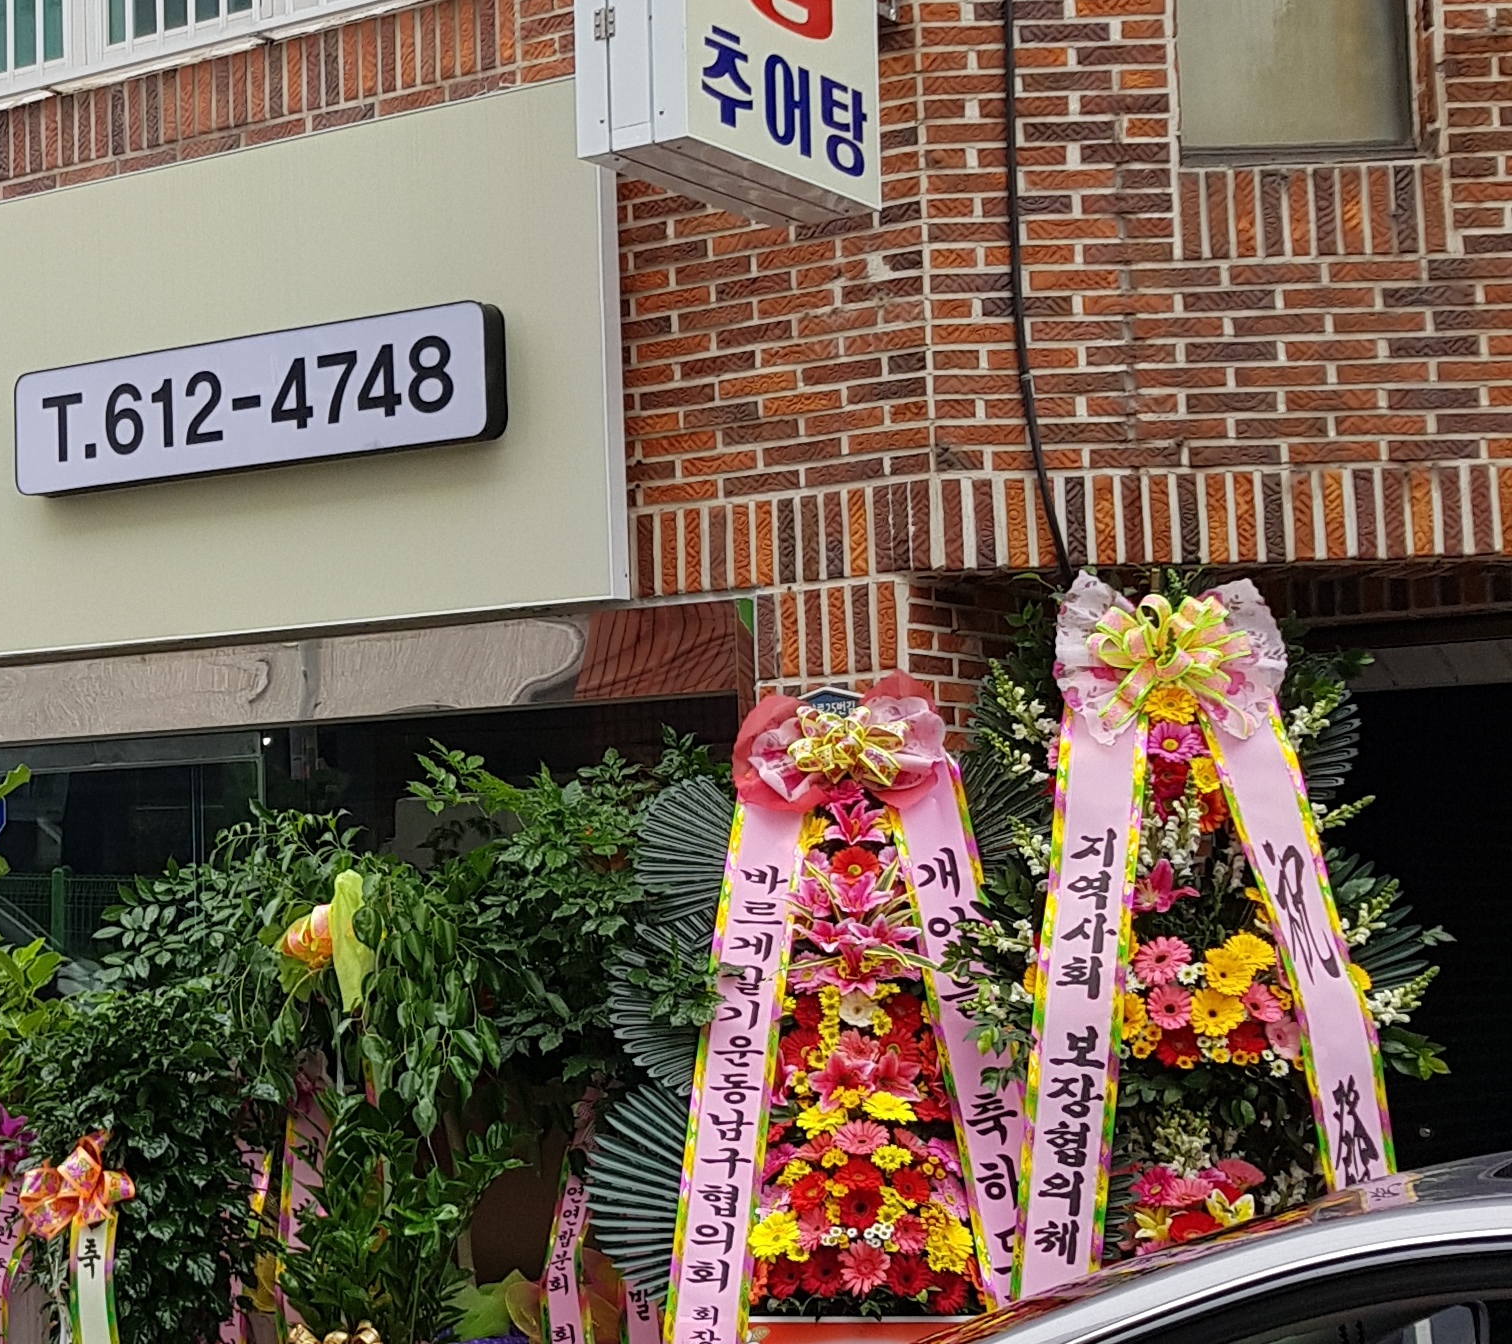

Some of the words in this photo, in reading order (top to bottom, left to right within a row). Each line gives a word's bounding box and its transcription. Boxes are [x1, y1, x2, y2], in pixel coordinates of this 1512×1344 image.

[700, 25, 867, 177] 추어탕
[41, 335, 455, 462] T.612-4748
[812, 700, 856, 715] 로25번길
[1055, 826, 1117, 1001] 지역사회
[965, 1092, 1019, 1280] 축하드
[1033, 1025, 1106, 1266] 보장협의체
[77, 1238, 101, 1279] 축
